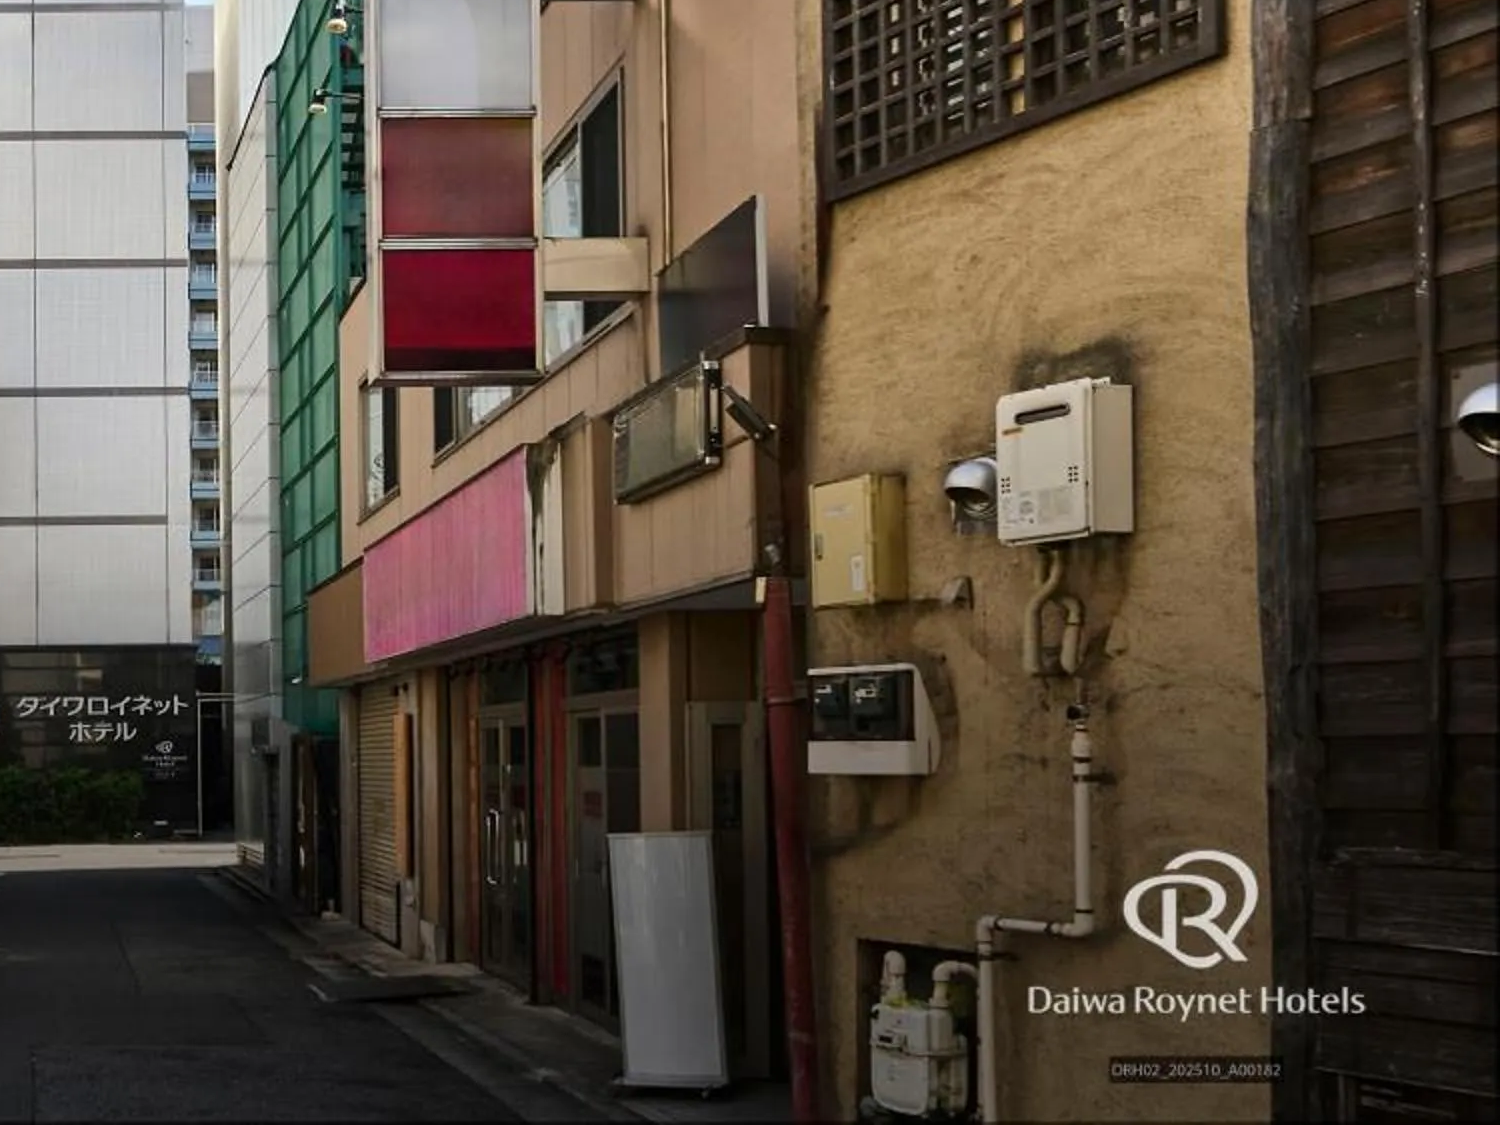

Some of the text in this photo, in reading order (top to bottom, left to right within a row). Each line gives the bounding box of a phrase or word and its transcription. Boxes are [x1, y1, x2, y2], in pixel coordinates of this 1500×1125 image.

[15, 694, 189, 718] ダイワロイネット
[68, 721, 138, 743] ホテル
